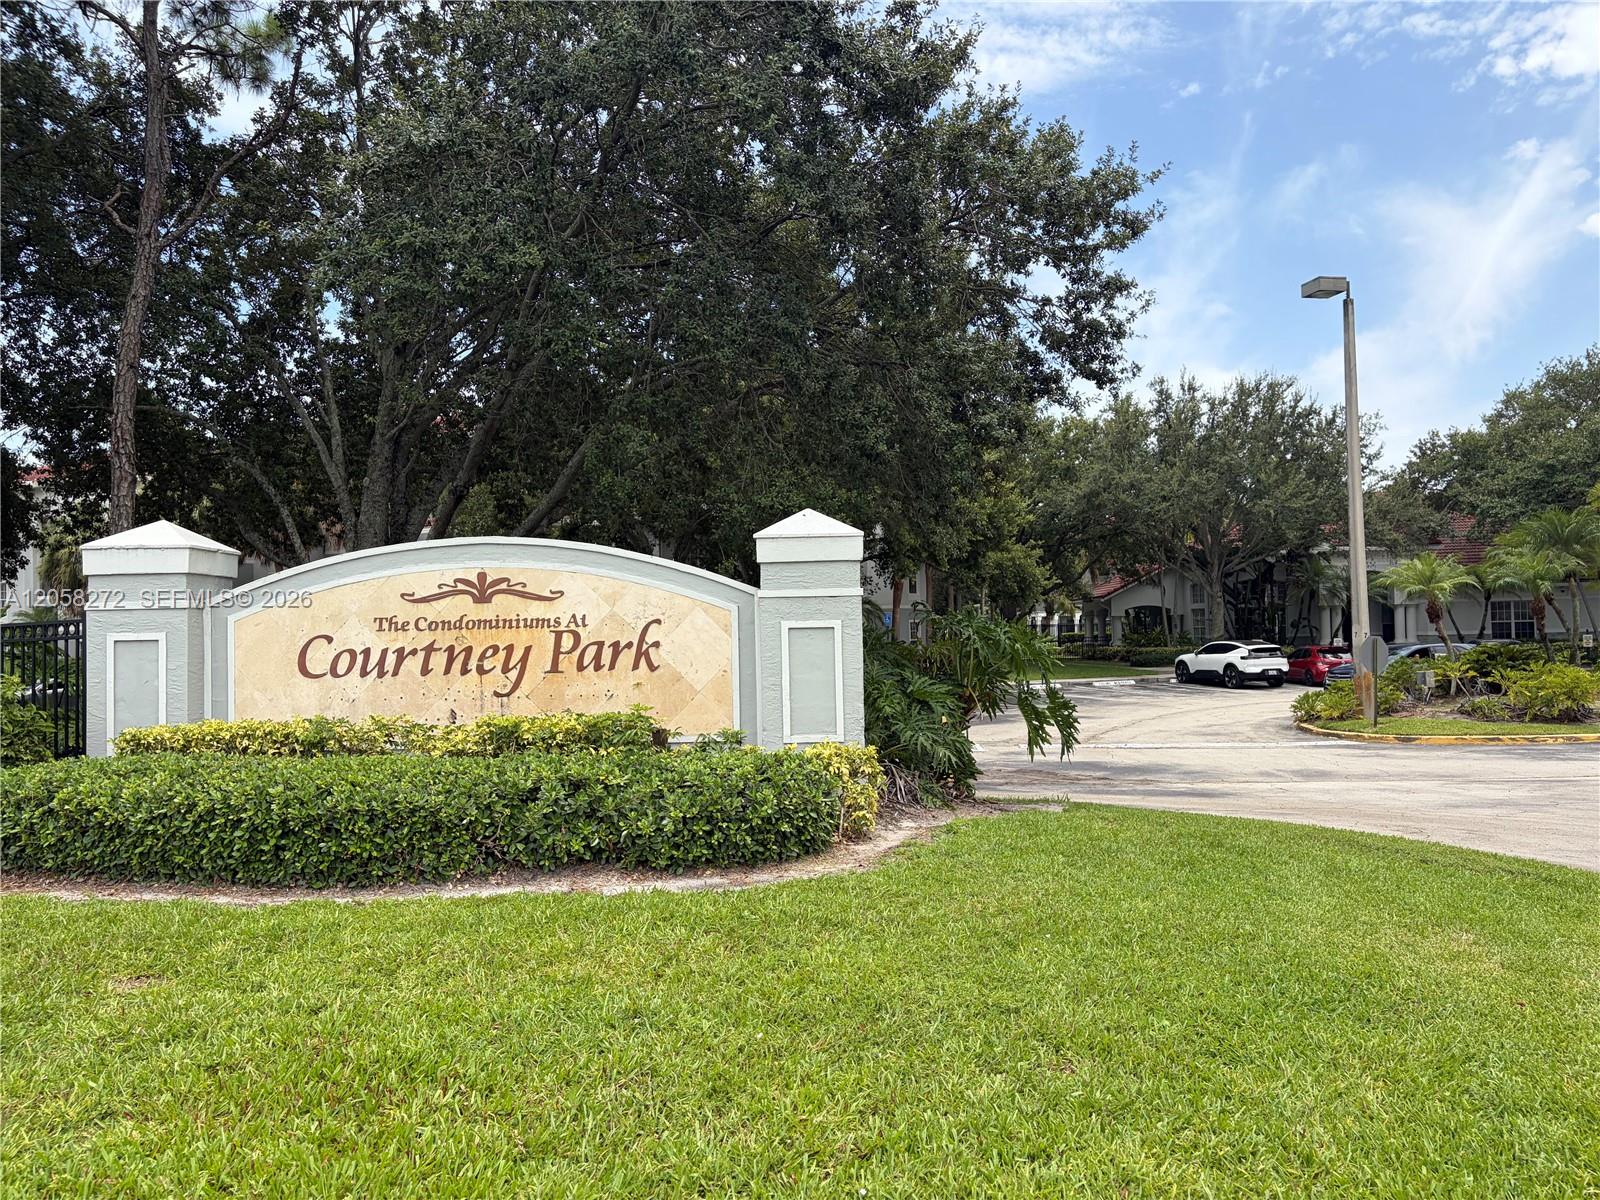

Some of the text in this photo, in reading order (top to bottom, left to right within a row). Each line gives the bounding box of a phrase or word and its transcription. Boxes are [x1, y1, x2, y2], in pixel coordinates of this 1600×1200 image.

[374, 613, 588, 632] The Condominiums At
[297, 618, 662, 698] Courtney Park
